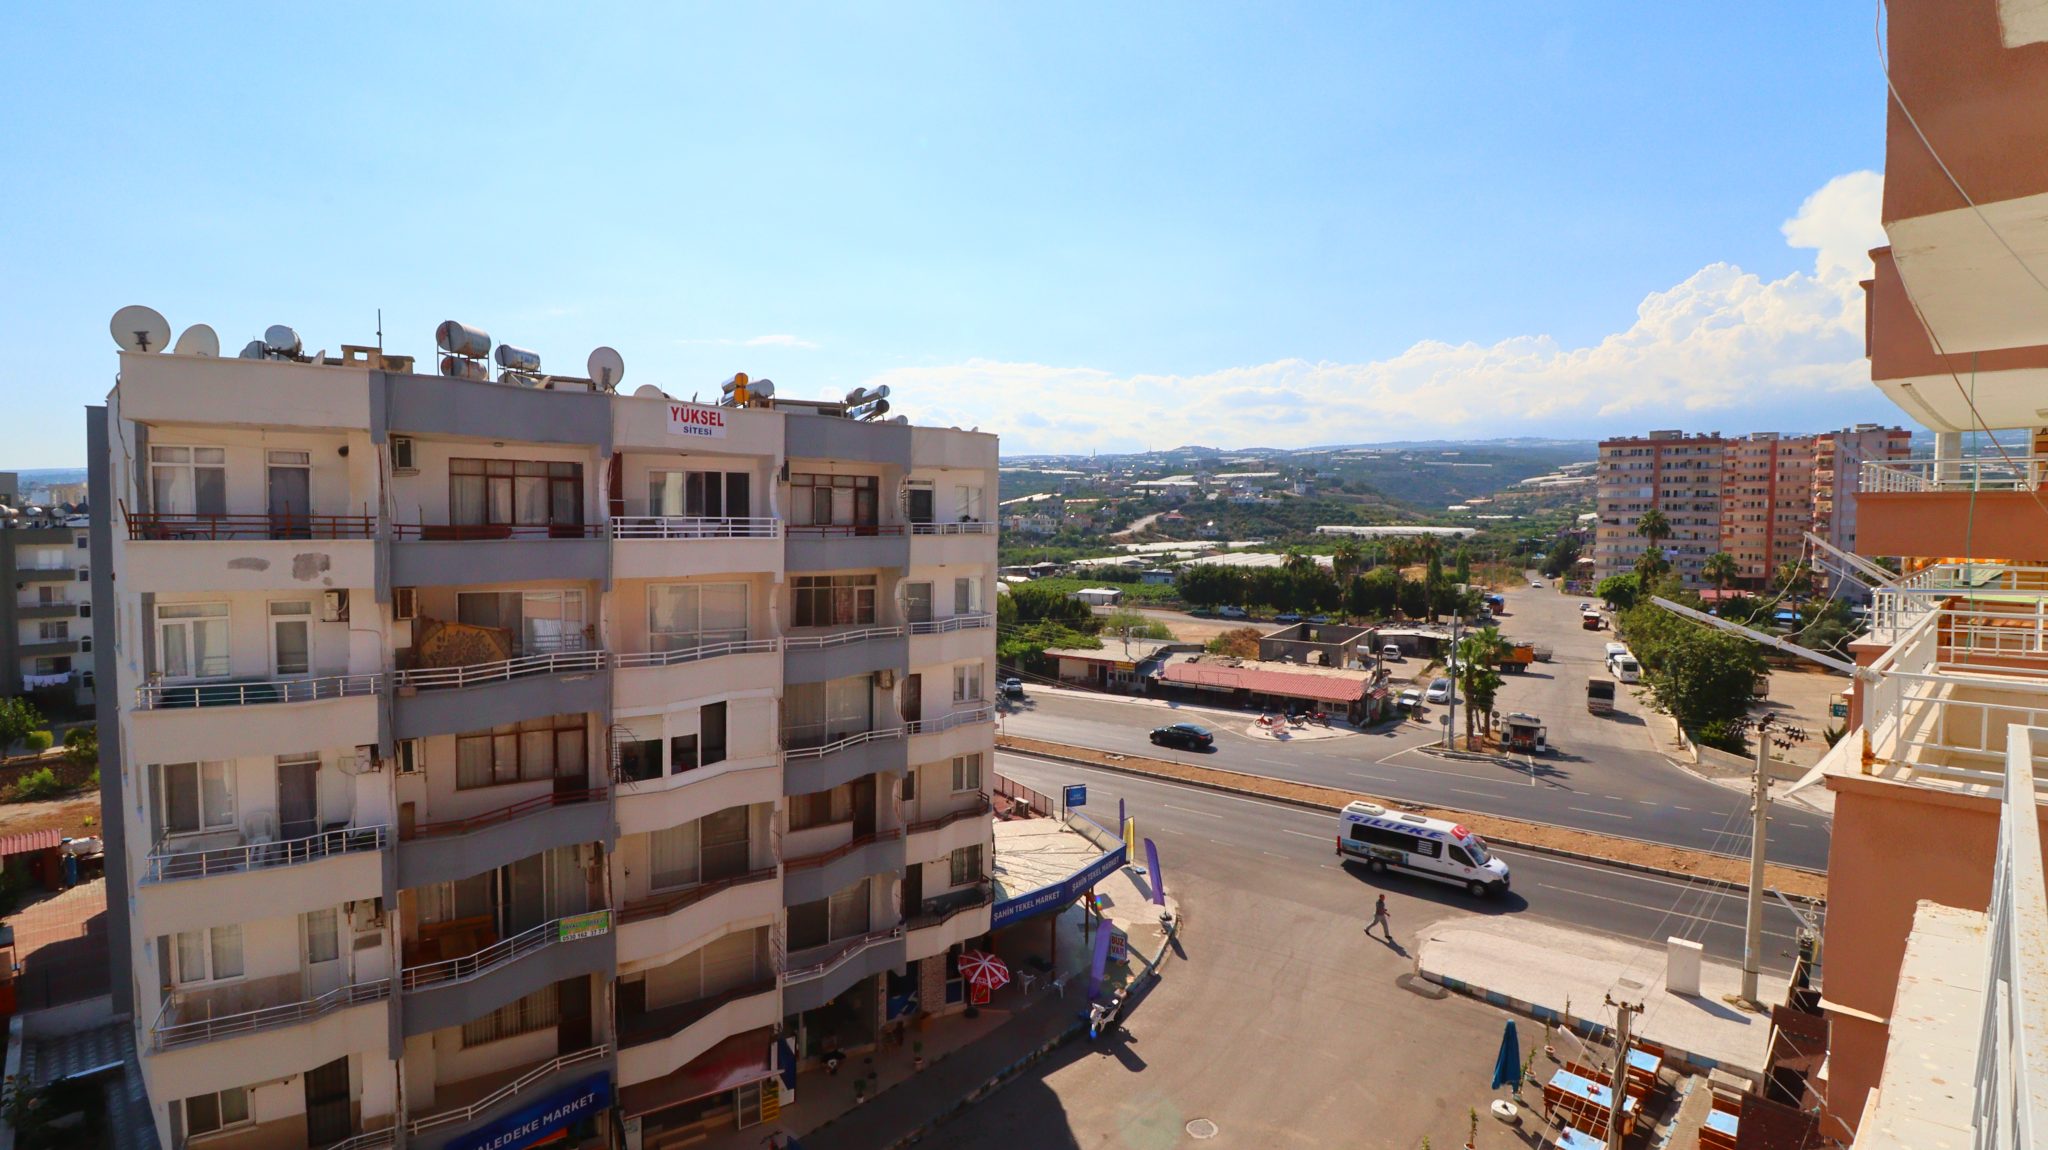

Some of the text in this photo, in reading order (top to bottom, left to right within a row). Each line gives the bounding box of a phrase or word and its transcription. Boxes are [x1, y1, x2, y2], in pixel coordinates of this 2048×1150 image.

[671, 405, 724, 427] YÜKSEL
[684, 425, 712, 436] SİTESİ
[1101, 856, 1120, 871] MARKET
[993, 891, 1060, 922] ŞAHİN TEKEL MARKET
[542, 1092, 596, 1126] MARKET
